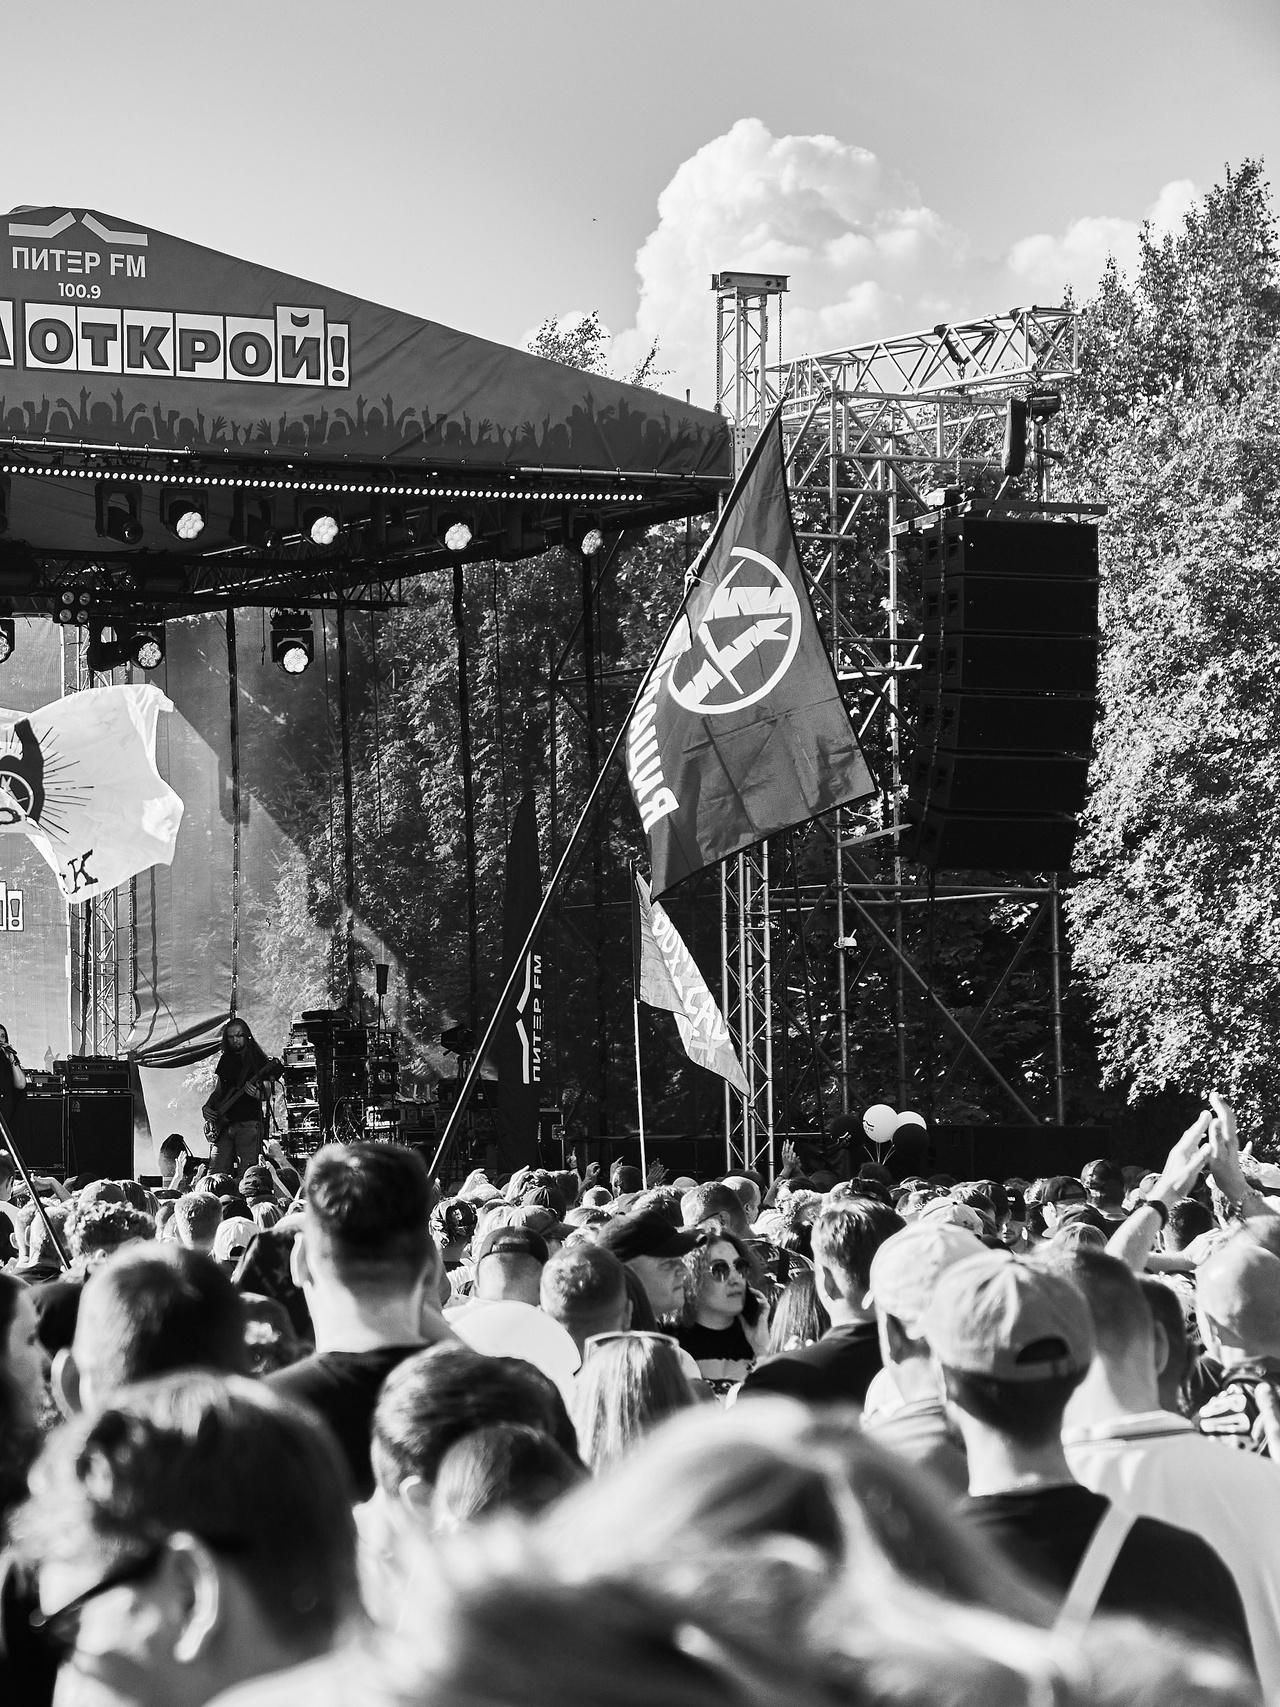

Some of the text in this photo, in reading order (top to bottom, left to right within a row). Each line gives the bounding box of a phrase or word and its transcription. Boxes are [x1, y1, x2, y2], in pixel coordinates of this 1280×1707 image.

[11, 246, 147, 278] ПИТЕР FM
[57, 282, 102, 300] 100.9
[27, 311, 347, 383] ОТКРОЙ!
[533, 954, 542, 990] FM
